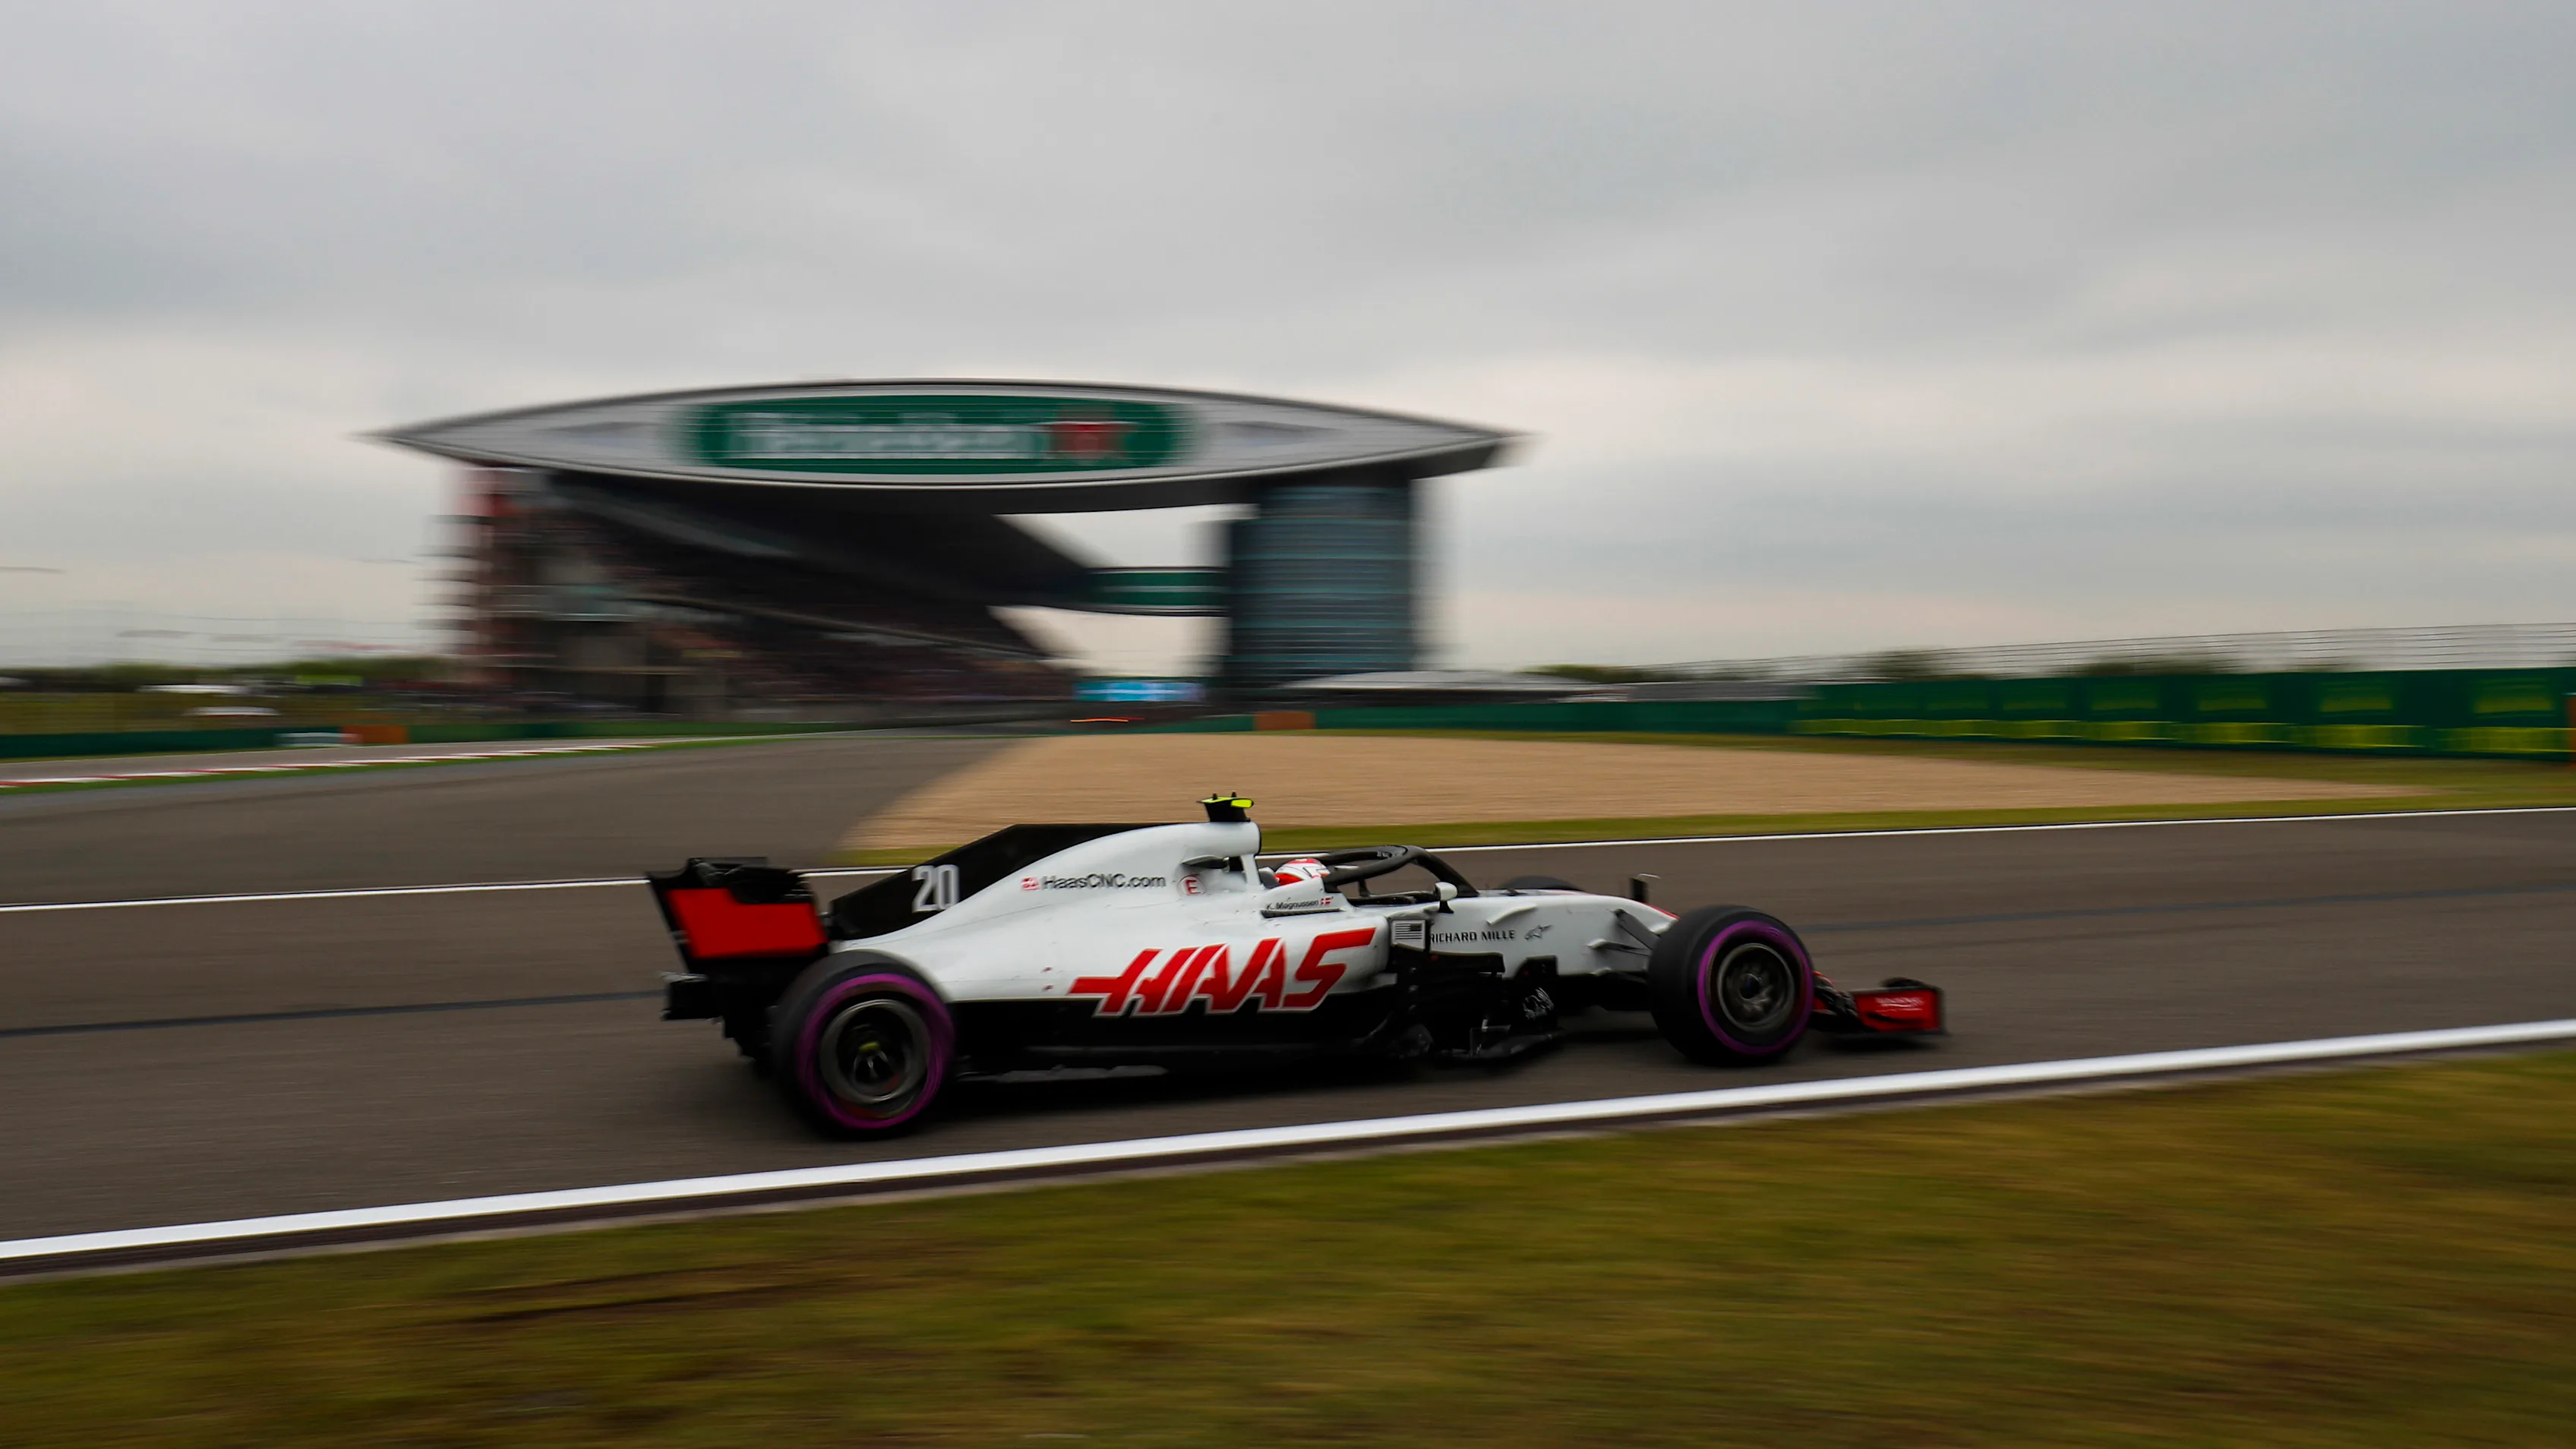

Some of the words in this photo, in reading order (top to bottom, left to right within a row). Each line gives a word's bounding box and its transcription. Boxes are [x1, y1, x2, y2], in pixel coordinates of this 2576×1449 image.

[911, 864, 960, 913] 20
[1042, 873, 1166, 890] HaasCNC.com
[1430, 931, 1477, 943] RICHARD
[1481, 930, 1516, 941] MILLE
[1065, 926, 1378, 1015] HAAS
